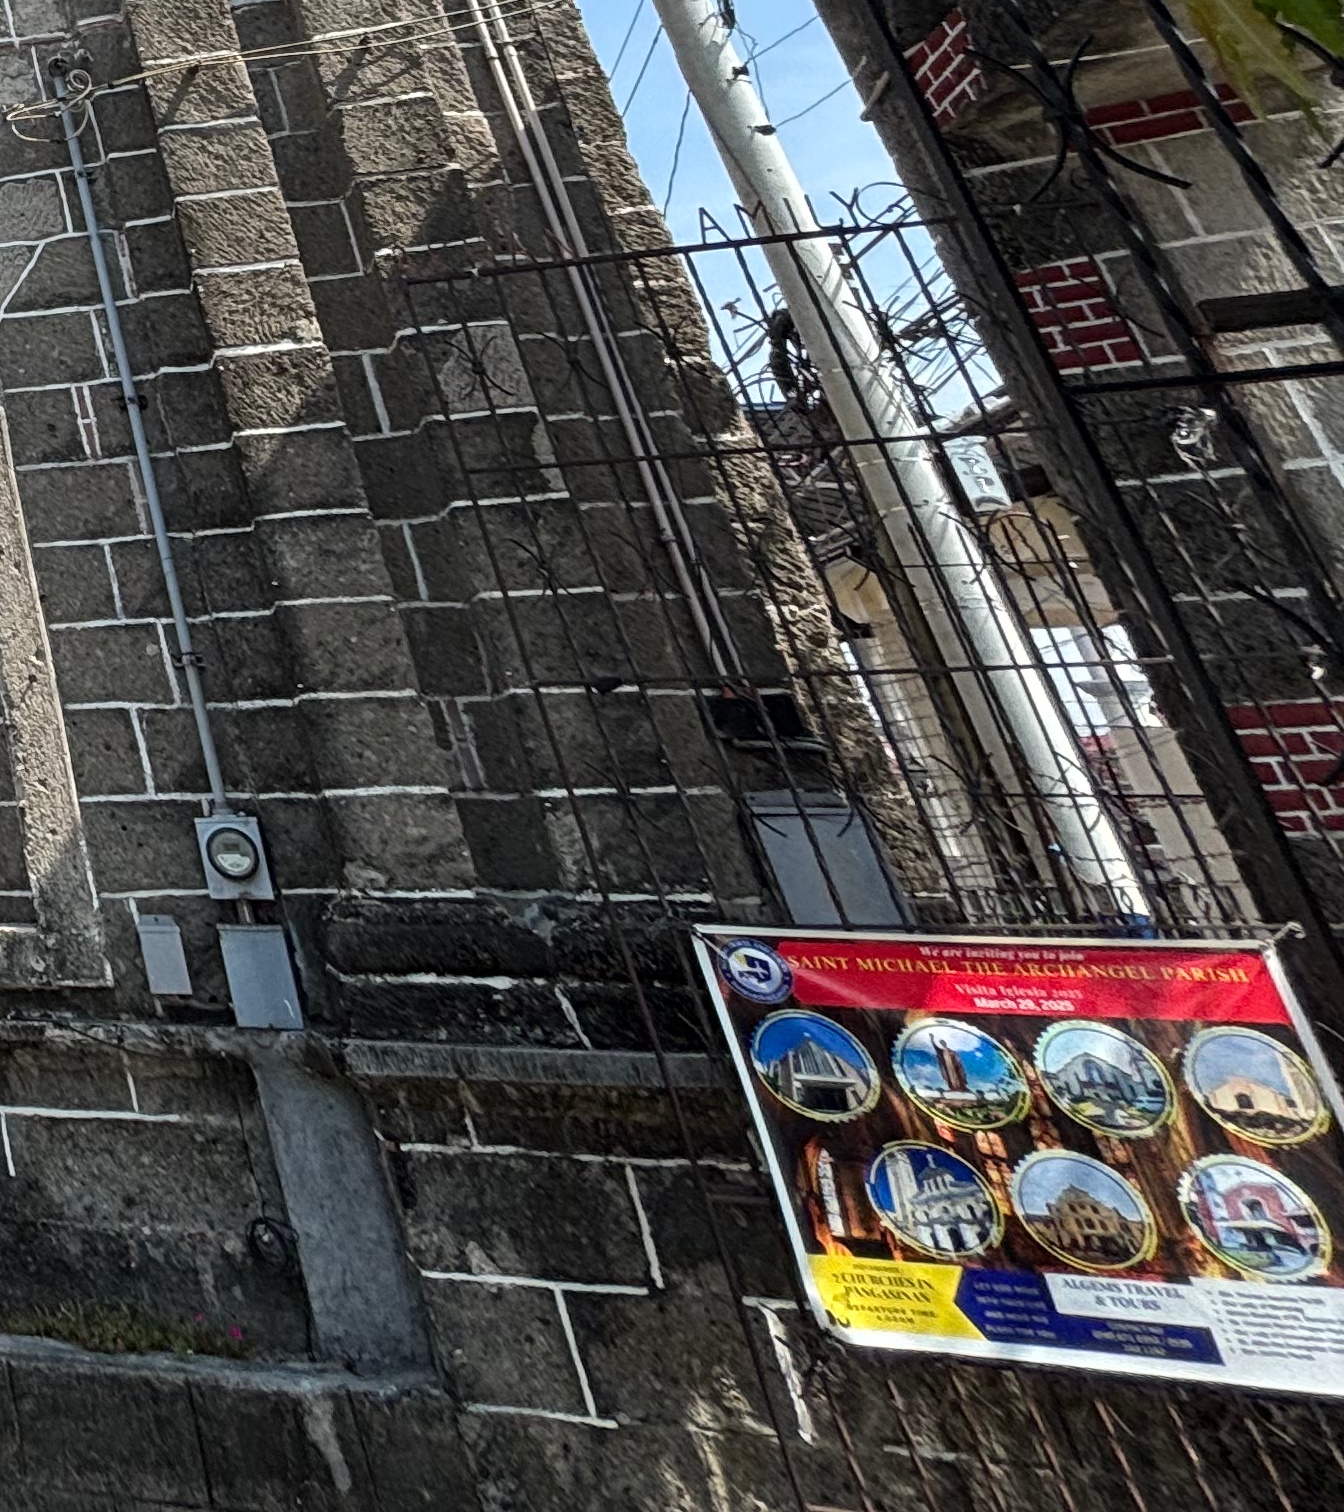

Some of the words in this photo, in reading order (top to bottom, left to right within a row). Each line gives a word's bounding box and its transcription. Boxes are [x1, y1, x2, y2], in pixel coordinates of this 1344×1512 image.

[788, 954, 849, 970] SAINT
[856, 956, 958, 975] MICHAEL
[961, 960, 1009, 976] THE
[1012, 962, 1156, 981] ARCHANGEL
[1159, 966, 1251, 984] PARISH
[972, 996, 1018, 1010] March
[841, 1272, 916, 1287] CHURCHES
[1123, 1283, 1186, 1299] TRAVEL
[1107, 1296, 1162, 1310] TOURS
